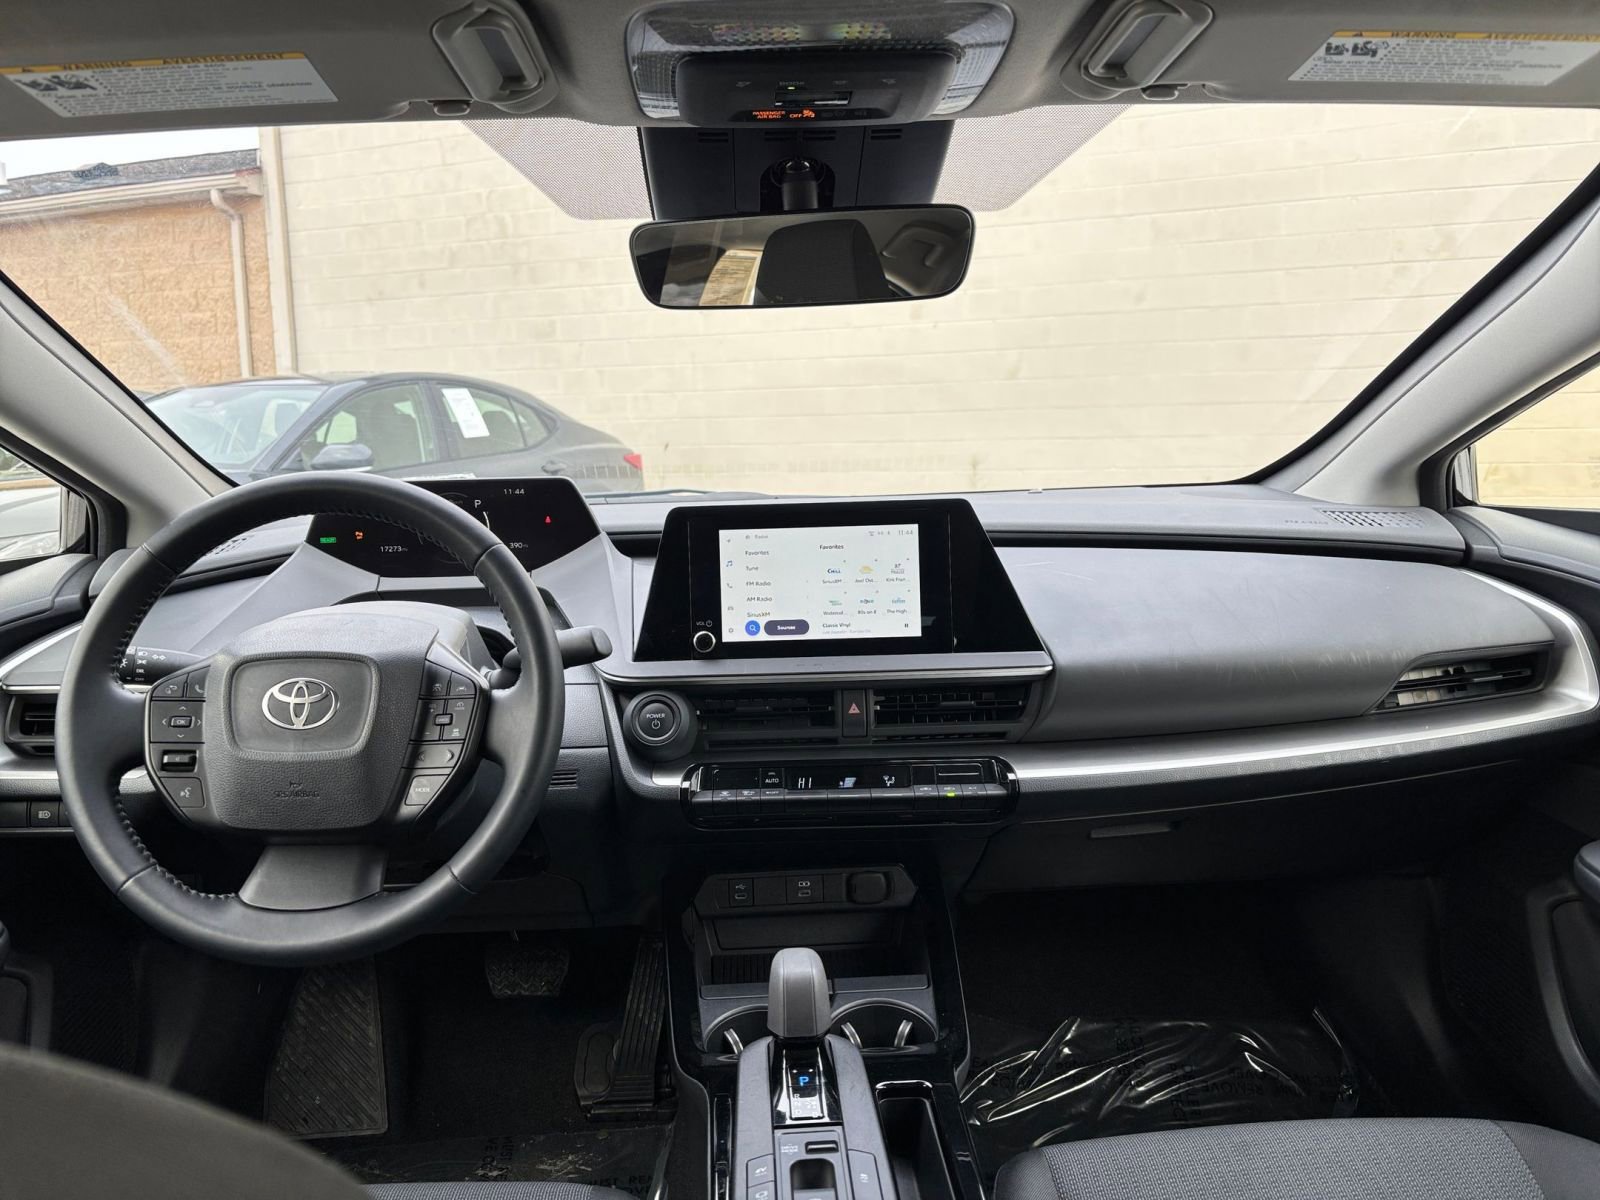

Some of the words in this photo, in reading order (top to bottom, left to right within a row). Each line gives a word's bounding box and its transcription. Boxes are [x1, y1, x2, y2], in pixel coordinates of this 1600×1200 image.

[474, 499, 482, 508] P
[798, 777, 812, 789] HI
[799, 1076, 809, 1087] P
